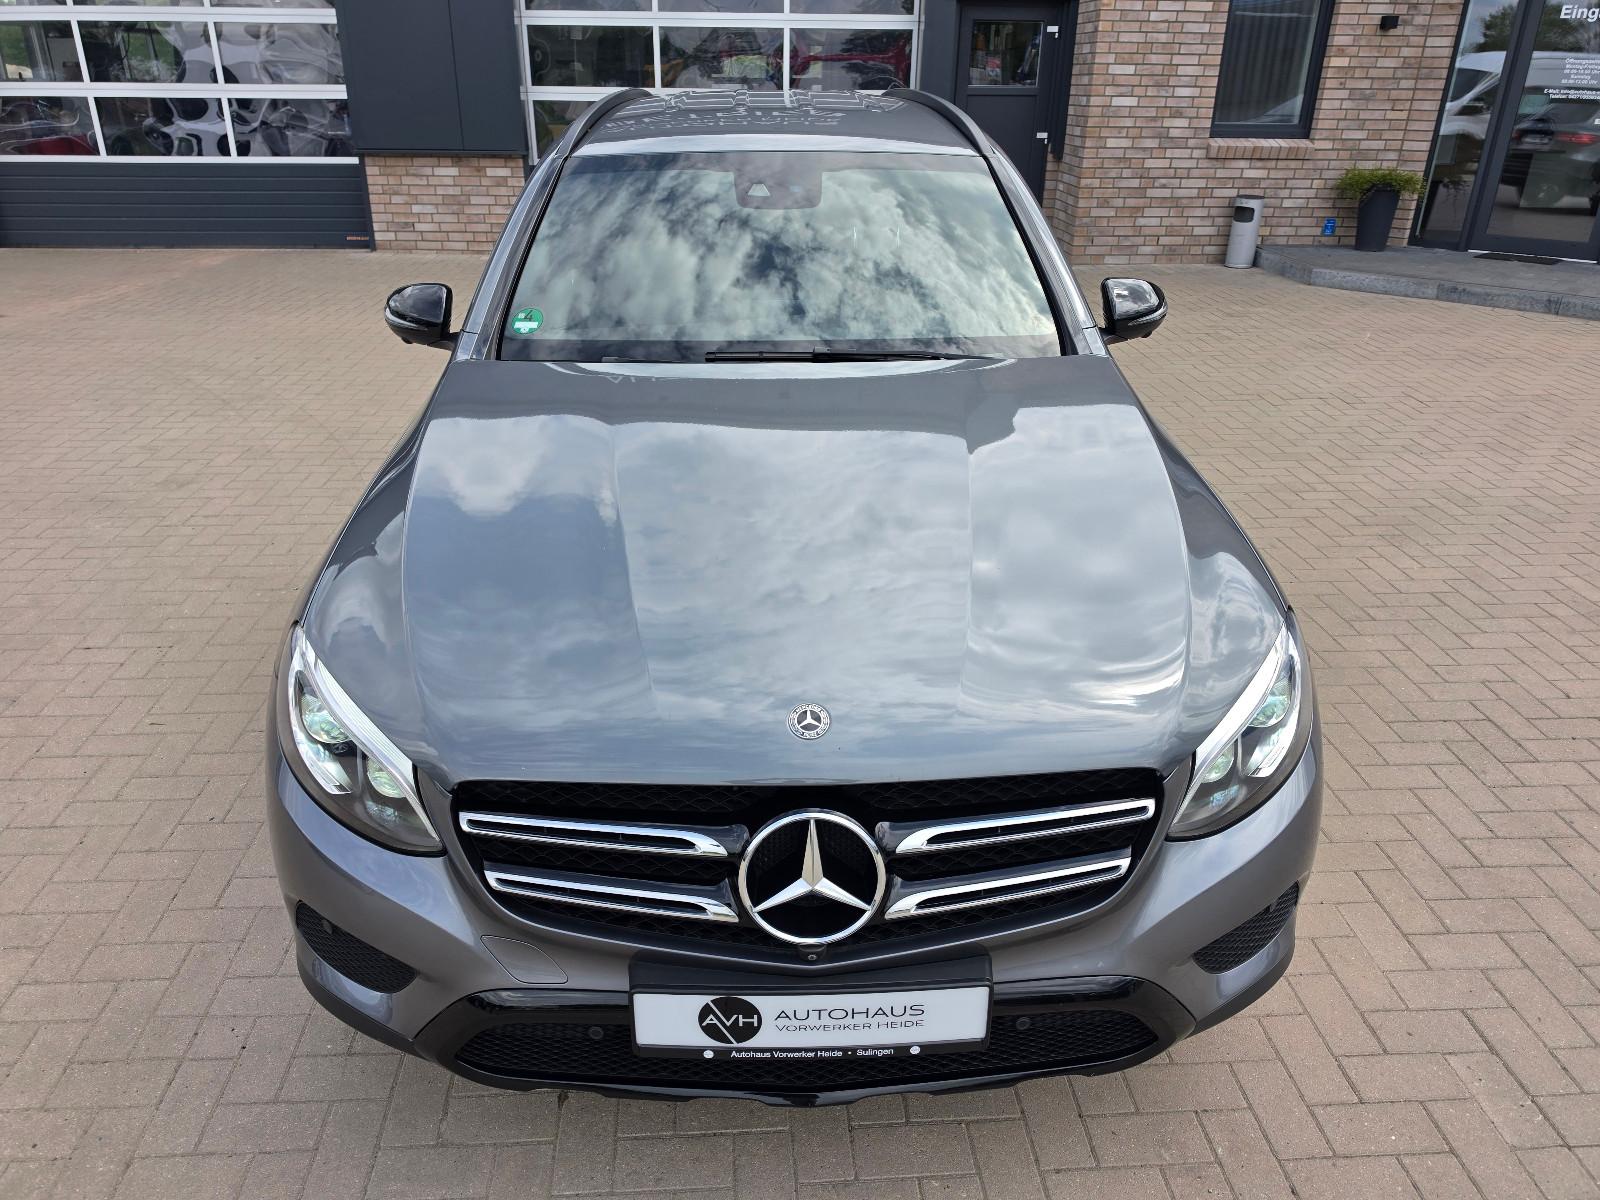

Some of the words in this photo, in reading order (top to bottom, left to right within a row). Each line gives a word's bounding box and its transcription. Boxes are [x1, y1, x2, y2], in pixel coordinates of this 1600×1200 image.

[1560, 4, 1600, 22] Eing
[775, 1005, 925, 1021] AUTOHAUS
[776, 1023, 872, 1032] VORWERKER
[877, 1020, 925, 1029] HEIDE
[731, 1050, 771, 1058] Autohaus
[773, 1050, 816, 1058] Vorwerker
[817, 1050, 843, 1058] Heide
[856, 1049, 894, 1057] Sulingen
